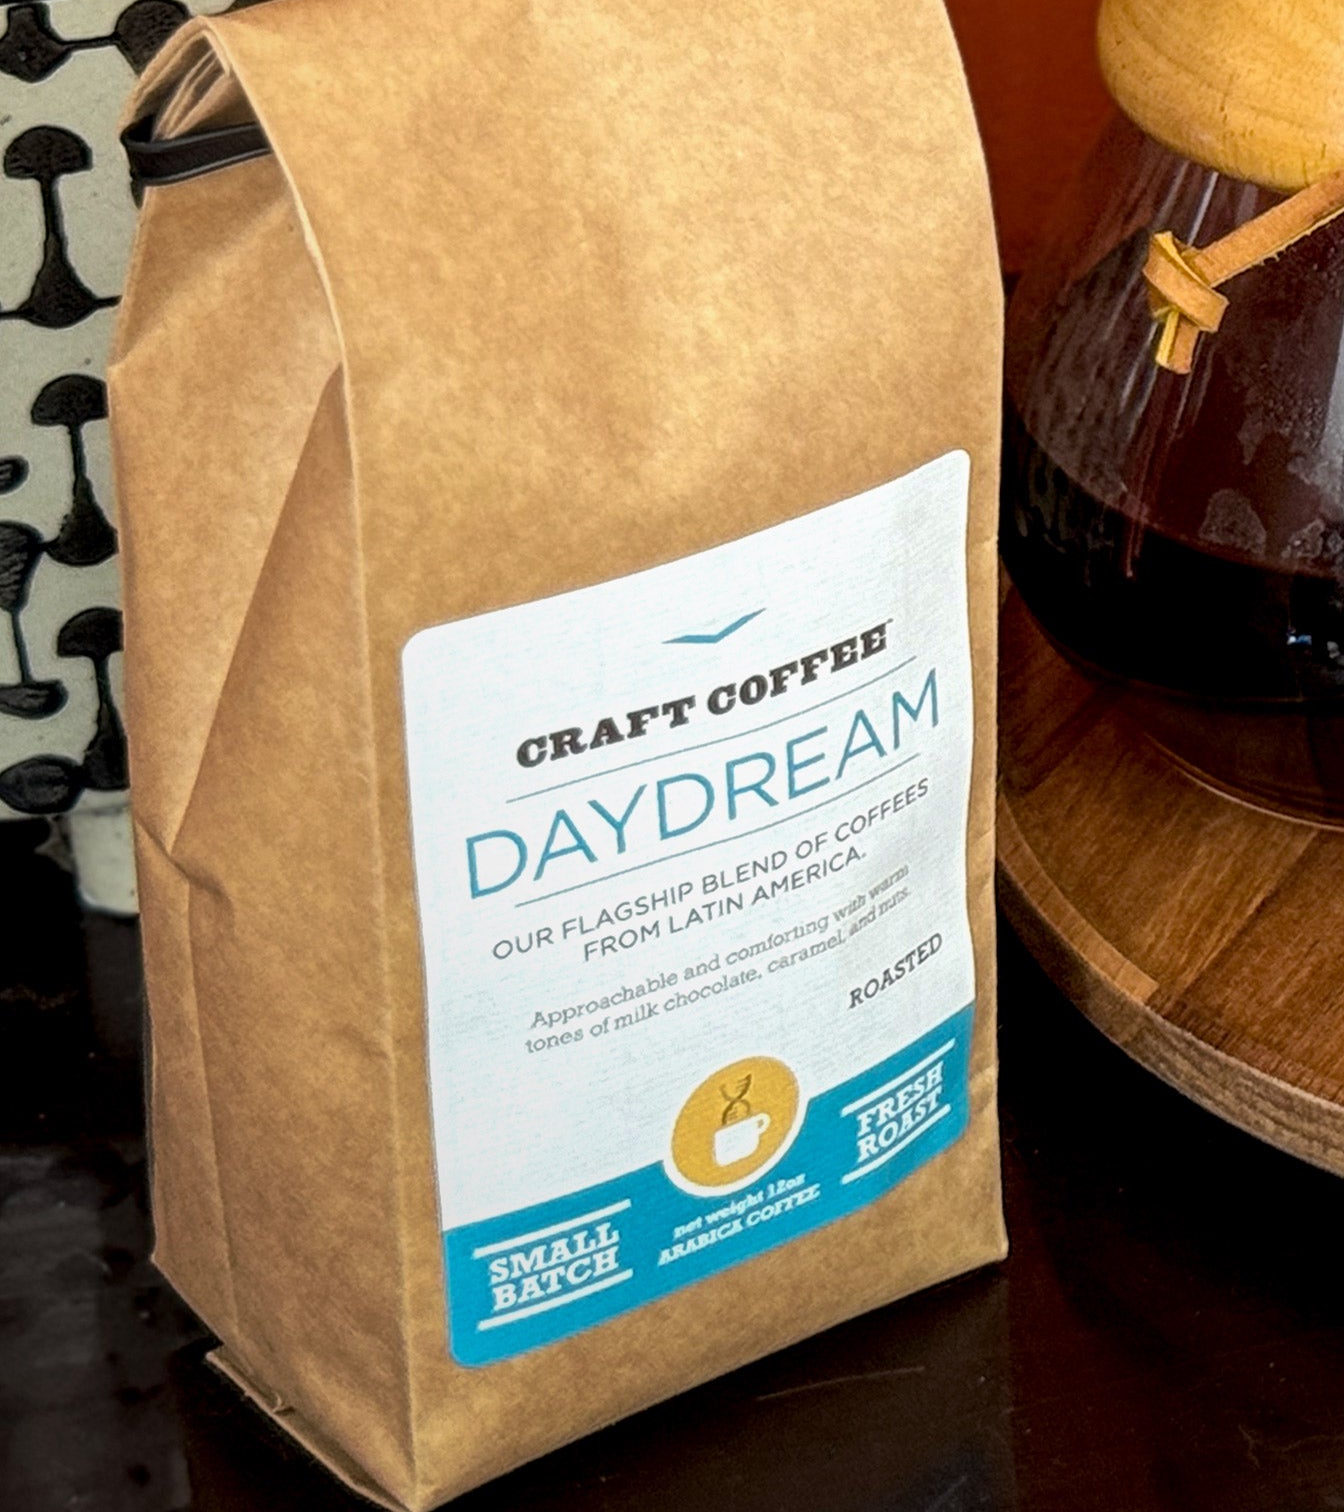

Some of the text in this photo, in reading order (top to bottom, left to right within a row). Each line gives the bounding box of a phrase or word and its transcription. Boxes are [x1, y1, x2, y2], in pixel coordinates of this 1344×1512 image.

[516, 621, 889, 769] CRAFT COFFEE
[466, 667, 941, 900] DAYDREAM
[492, 777, 929, 961] OUR FLAGSHIP BLEND OF COFFEES
[584, 845, 867, 963] FROM LATIN AMERICA.
[525, 1027, 585, 1054] tones
[589, 1016, 612, 1039] of
[614, 1001, 661, 1031] milk
[663, 967, 763, 1014] chocolate,
[767, 928, 846, 973] caramel,
[848, 904, 877, 937] and
[530, 971, 679, 1030] Approachable
[684, 952, 721, 981] and
[725, 914, 830, 966] comforting
[832, 894, 867, 922] with
[848, 932, 943, 1009] ROASTED
[857, 1060, 944, 1137] FRESH
[857, 1085, 943, 1163] ROAST
[657, 1183, 821, 1267] ARABICA COFFEE
[673, 1173, 806, 1240] net weight 12oz
[488, 1221, 621, 1286] SMALL
[490, 1245, 620, 1314] BATCH
